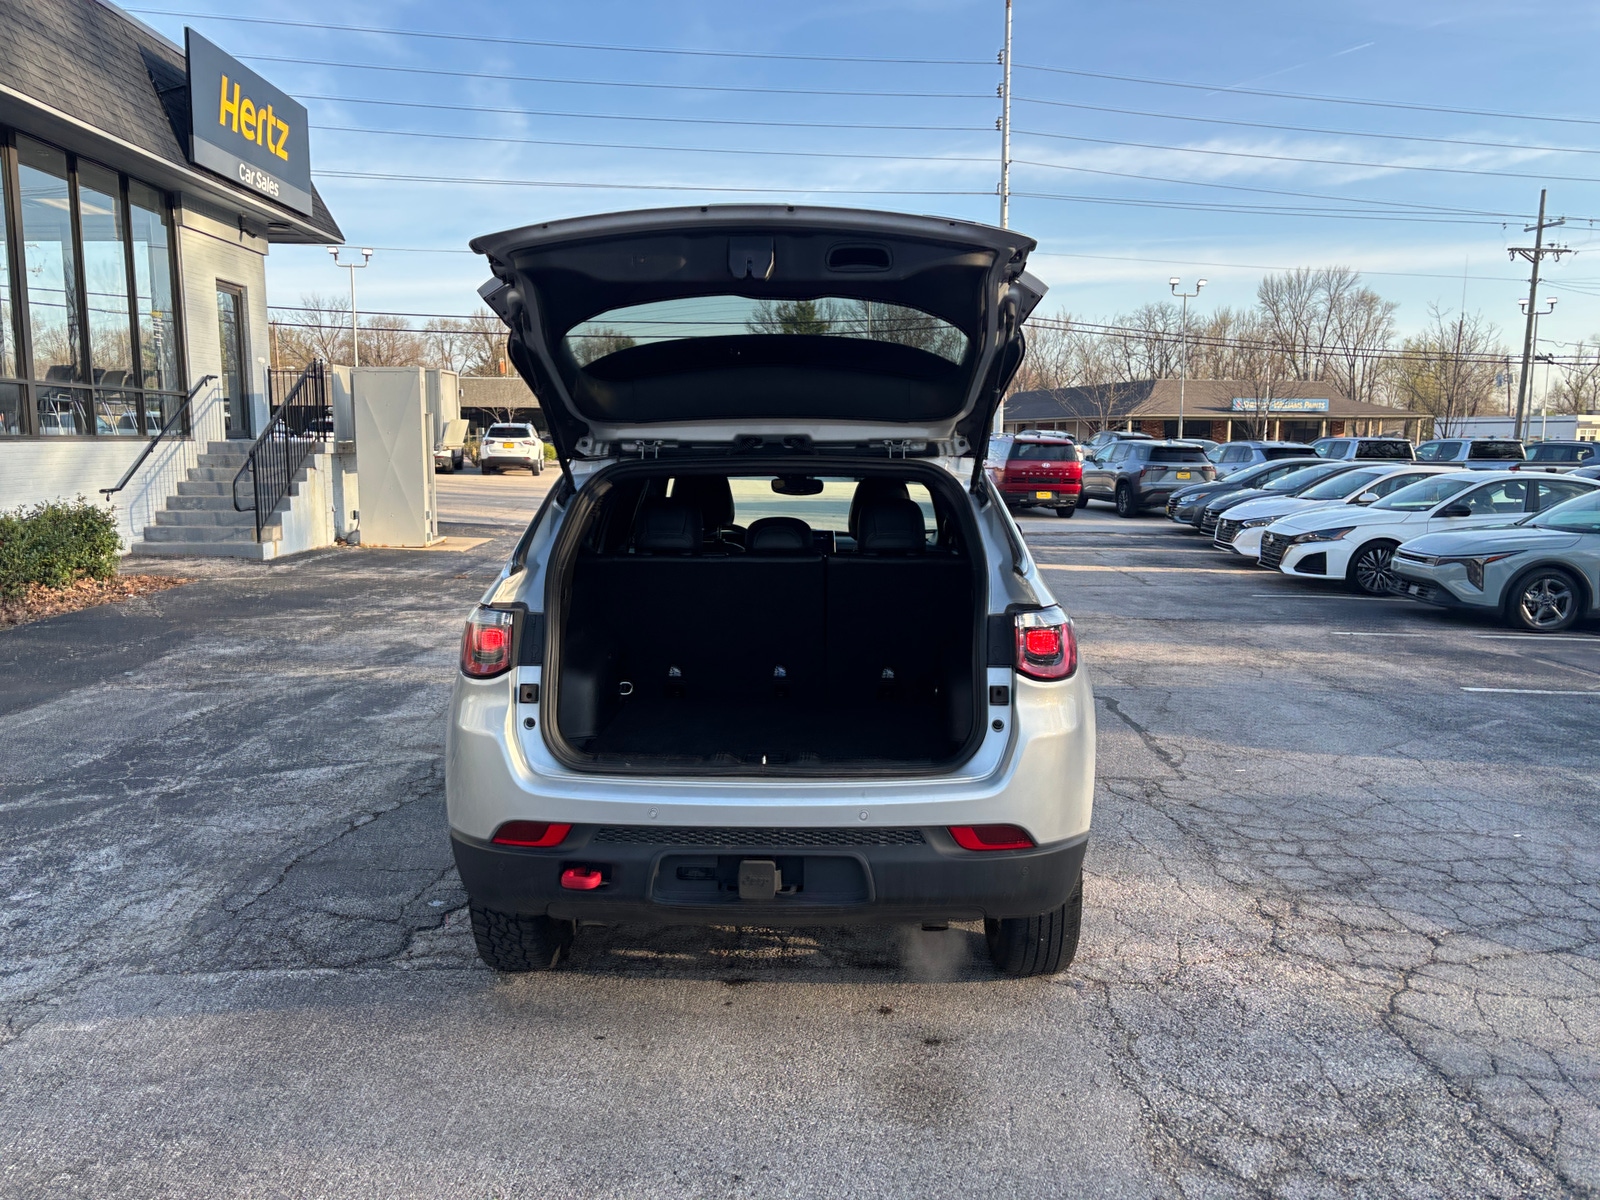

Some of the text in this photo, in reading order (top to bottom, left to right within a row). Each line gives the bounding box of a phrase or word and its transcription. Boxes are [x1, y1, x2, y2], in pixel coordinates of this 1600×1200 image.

[219, 74, 290, 161] Hertz
[239, 163, 280, 197] Car Sales
